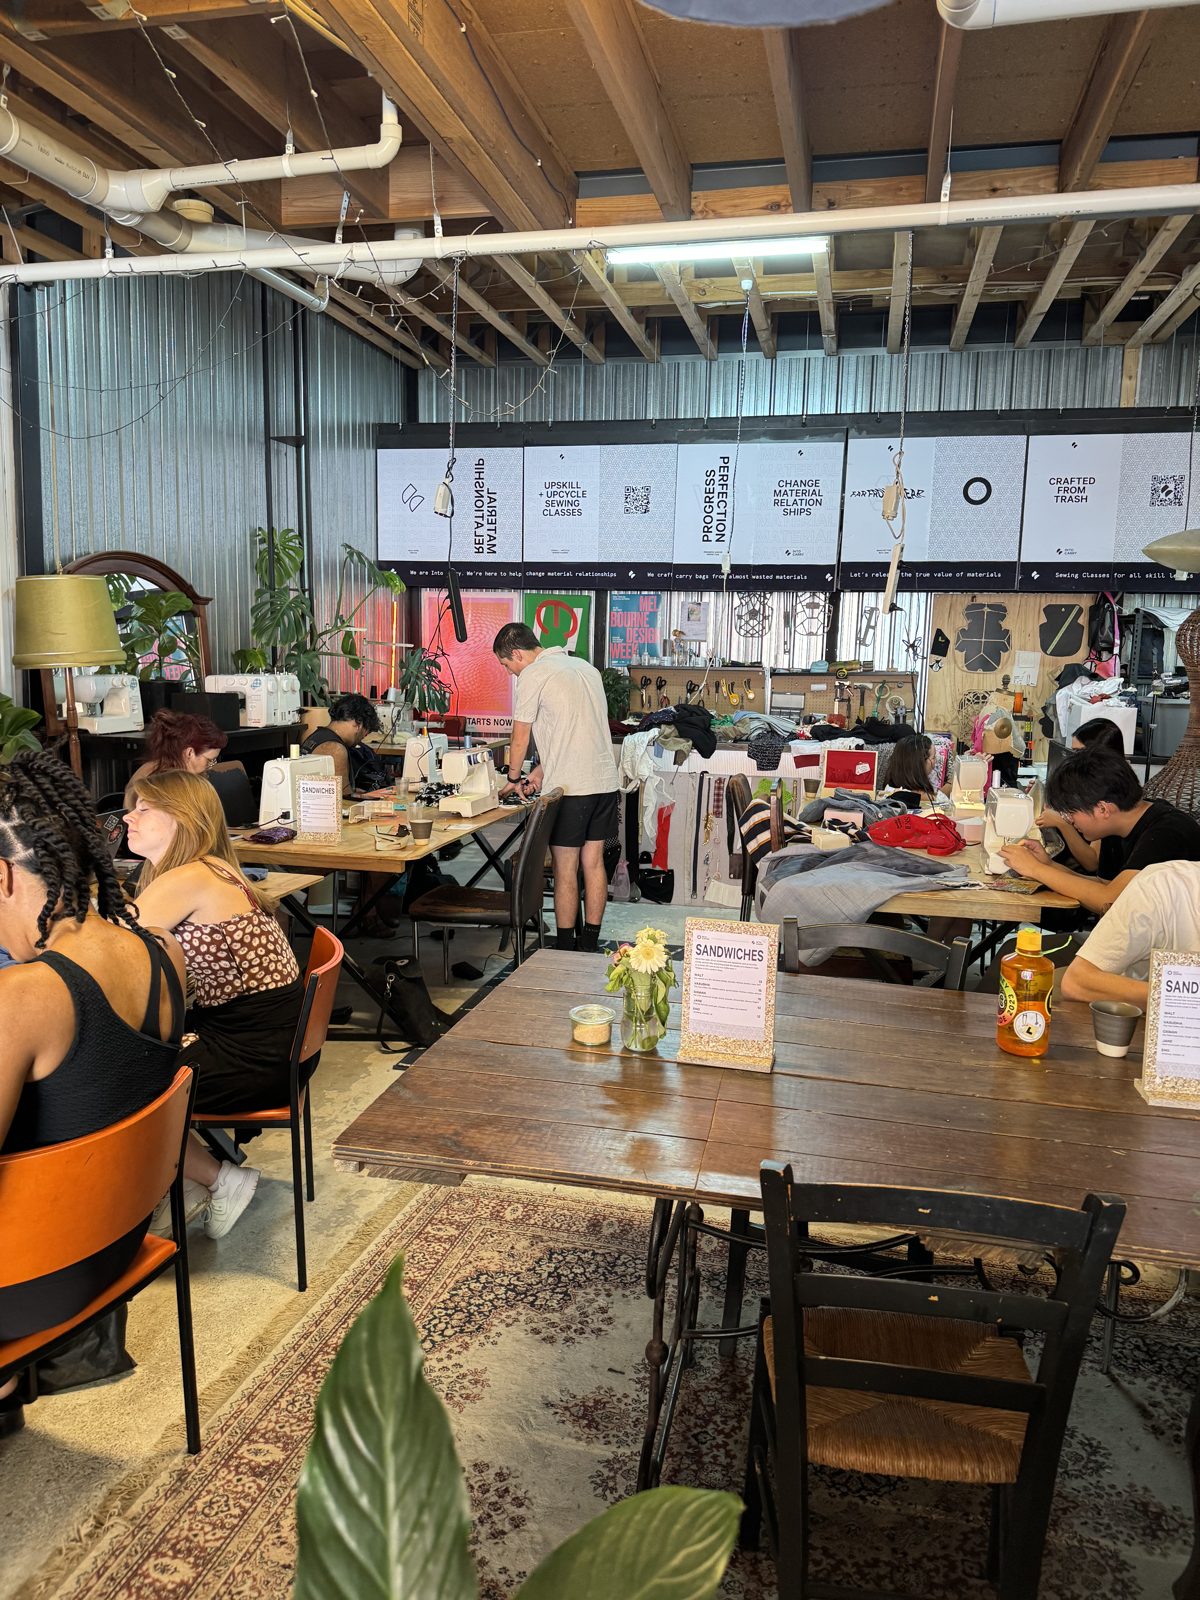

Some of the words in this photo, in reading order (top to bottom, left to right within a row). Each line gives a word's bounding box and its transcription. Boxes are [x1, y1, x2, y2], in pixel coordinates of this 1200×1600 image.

[544, 481, 581, 489] UPSKILL
[778, 479, 820, 488] CHANGE
[1049, 477, 1096, 486] CRAFTED
[546, 490, 587, 498] UPCYCLE
[774, 489, 823, 497] MATERIAL
[1057, 486, 1086, 494] FROM
[715, 456, 730, 542] PERFECTION
[774, 498, 823, 506] RELATION
[1054, 495, 1088, 503] TRASH
[702, 469, 716, 542] PROGRESS
[542, 509, 582, 517] CLASSES
[782, 508, 812, 516] SHIPS
[640, 596, 657, 612] MEL
[610, 611, 650, 628] BOURNE
[610, 642, 639, 659] WEEK
[467, 718, 491, 726] TARTS
[302, 786, 335, 794] SANDWICHES
[696, 944, 764, 962] SANDWICHES
[1166, 980, 1200, 994] SAND
[1006, 994, 1015, 1017] 2023
